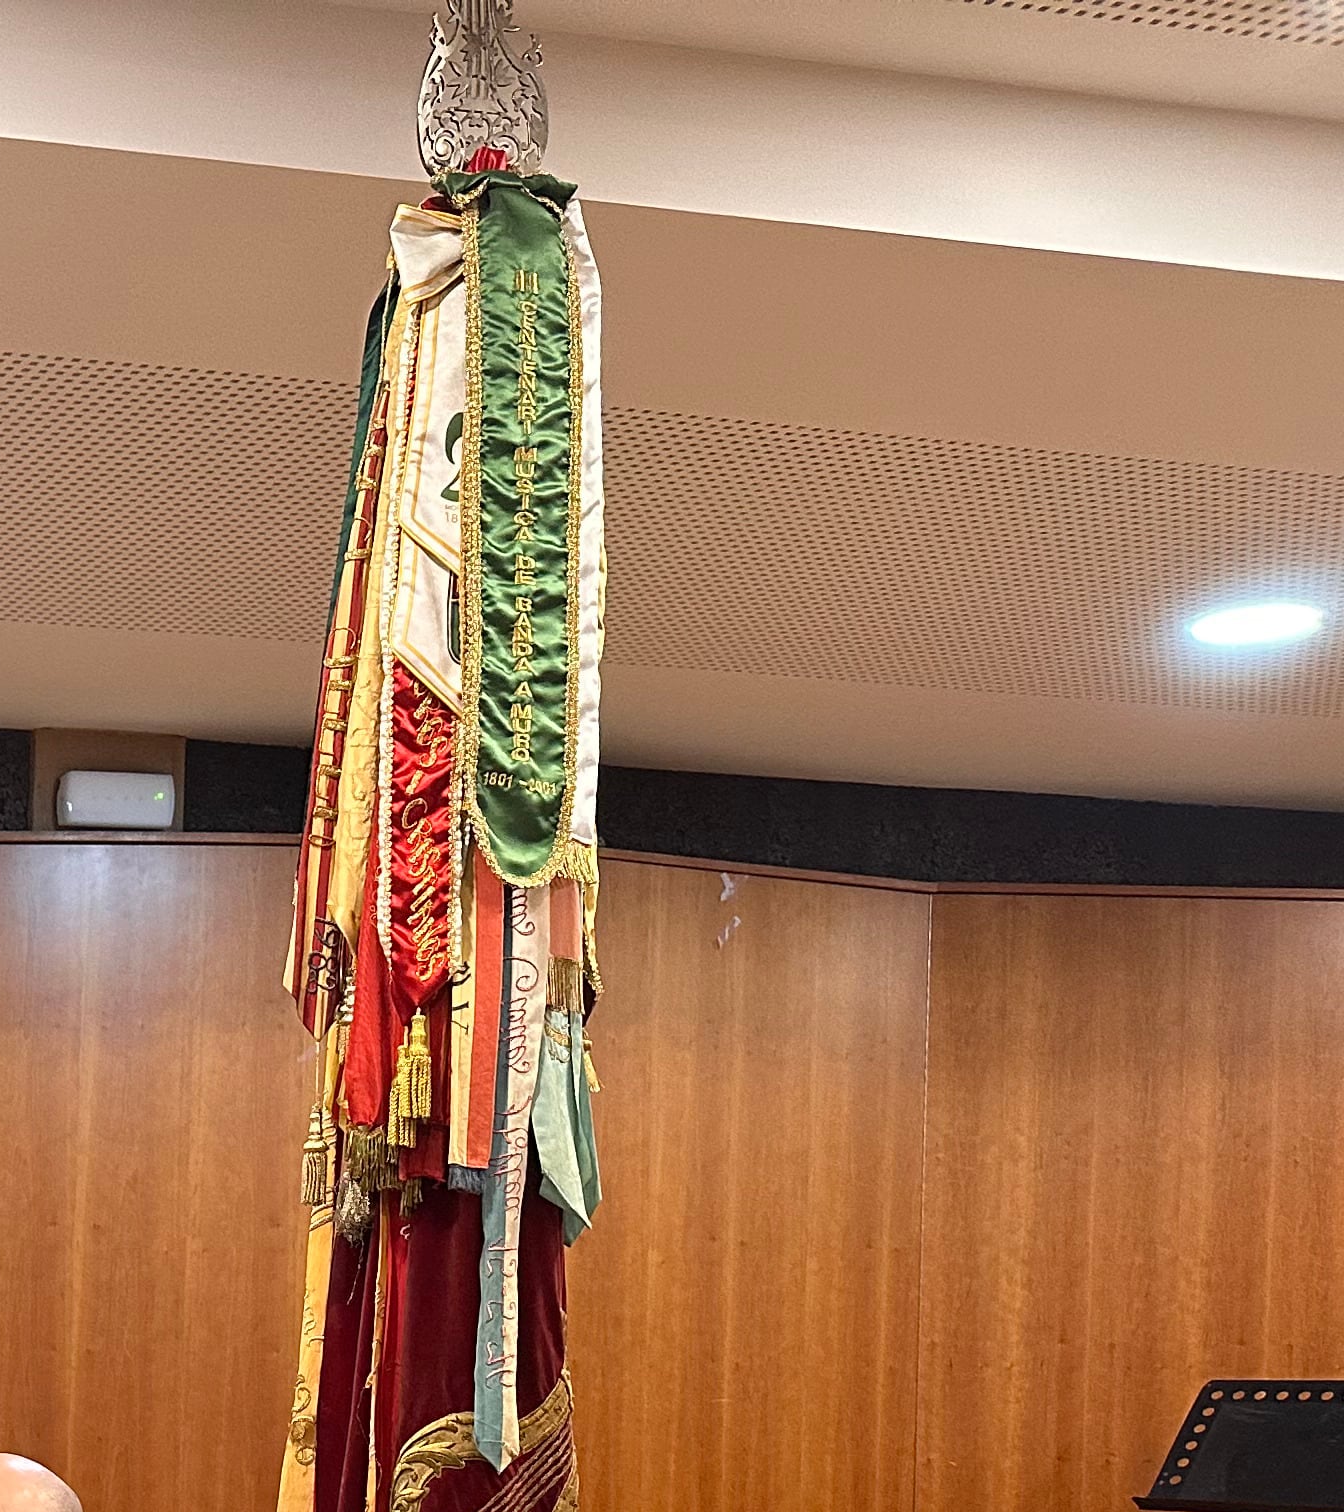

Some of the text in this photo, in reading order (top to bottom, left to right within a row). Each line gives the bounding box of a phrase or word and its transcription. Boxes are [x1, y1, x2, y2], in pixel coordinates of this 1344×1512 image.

[517, 300, 538, 436] CENTENARI
[514, 554, 536, 585] DE
[512, 596, 540, 675] BANDA
[514, 681, 533, 697] A
[510, 703, 534, 762] MURO
[482, 771, 514, 789] 1801
